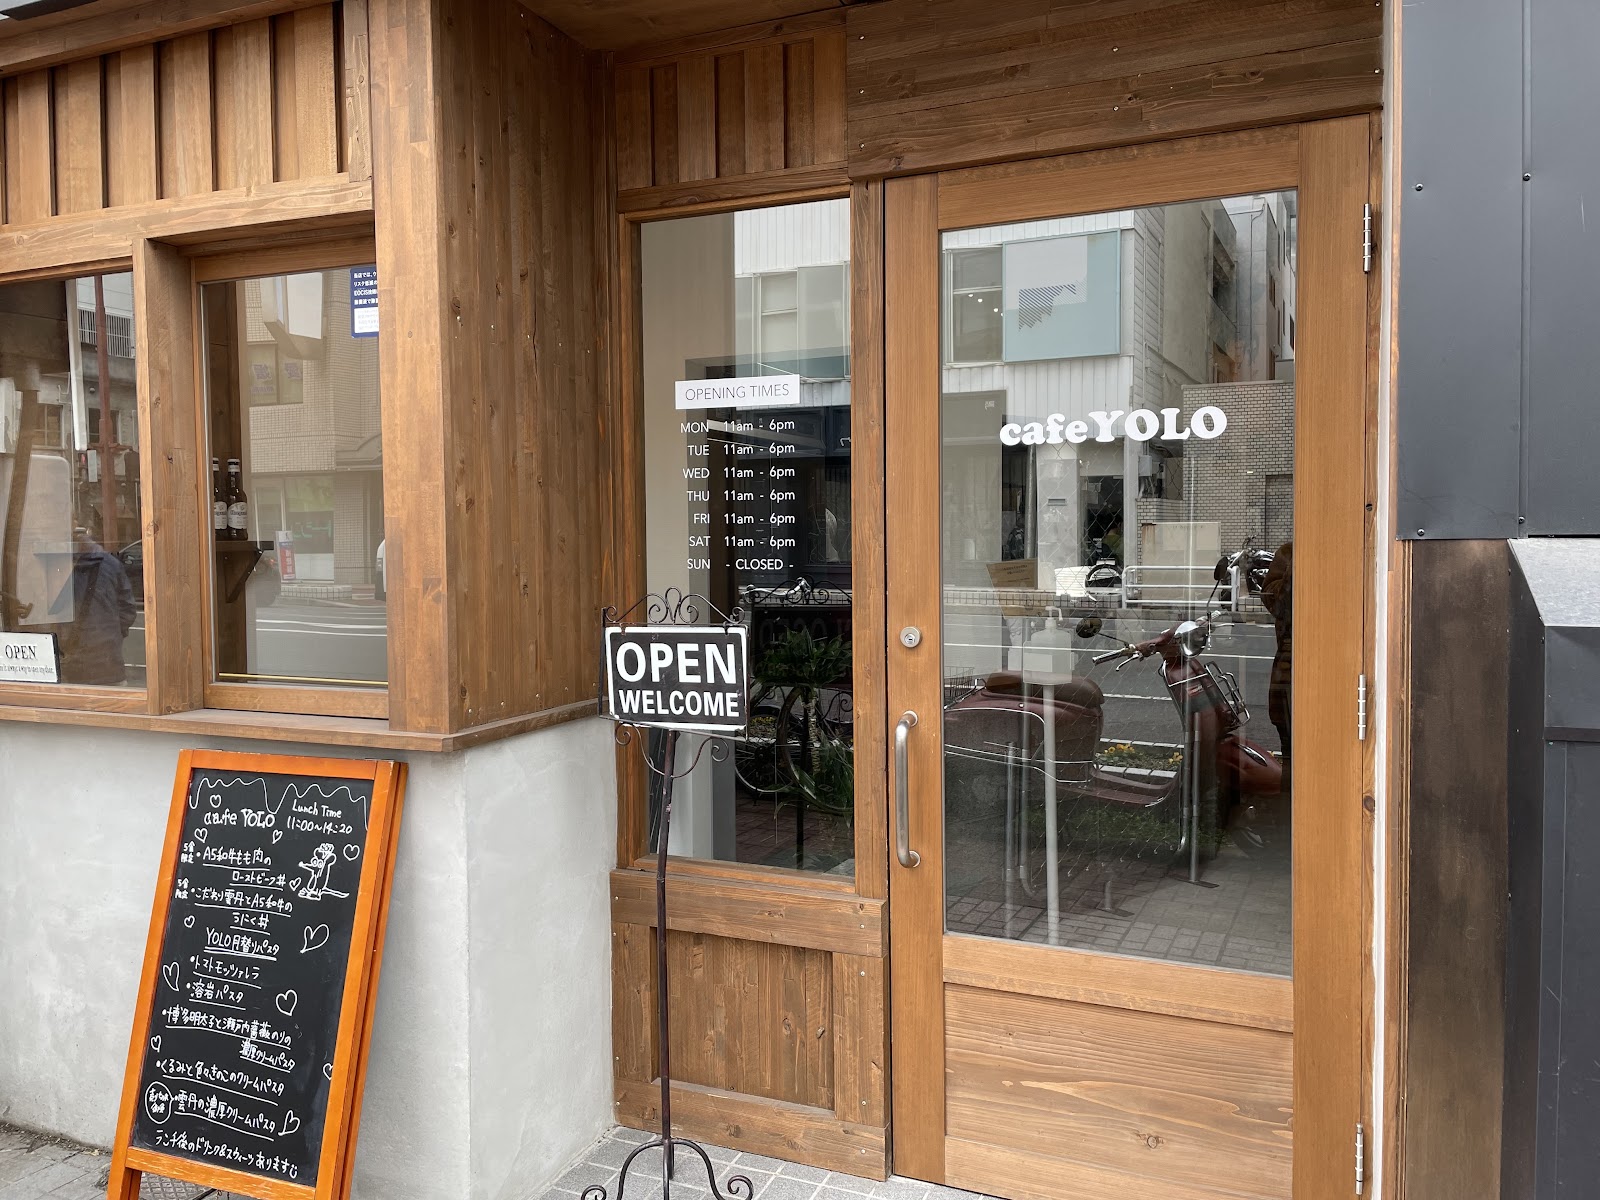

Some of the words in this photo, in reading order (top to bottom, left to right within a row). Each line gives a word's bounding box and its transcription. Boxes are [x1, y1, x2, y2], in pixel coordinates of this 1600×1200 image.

[685, 385, 746, 401] OPENING
[749, 383, 790, 398] TIMES
[680, 421, 709, 433] MON
[724, 420, 754, 432] 11am
[769, 418, 796, 433] 6pm
[1000, 405, 1228, 446] cafeYOLO
[688, 445, 710, 456] TUE
[724, 444, 754, 455] 11am
[769, 442, 796, 456] 6pm
[683, 468, 710, 479] WED
[724, 467, 754, 478] 11am
[769, 465, 796, 480] 6pm
[687, 491, 710, 502] THU
[724, 490, 754, 501] 11am
[769, 489, 796, 503] 6pm
[693, 513, 710, 524] FRI
[724, 513, 754, 524] 11am
[769, 512, 796, 526] 6pm
[689, 536, 711, 547] SAT
[724, 536, 754, 547] 11am
[769, 535, 796, 550] 6pm
[687, 559, 711, 570] SUN
[735, 559, 783, 570] CLOSED
[5, 644, 38, 661] OPEN
[616, 642, 737, 684] OPEN
[618, 689, 740, 717] WELCOME
[292, 799, 318, 816] Lunch
[321, 804, 342, 819] Time
[204, 808, 238, 826] cafe
[241, 808, 276, 829] YOLO
[206, 926, 280, 955] YOLO月替りパスタ
